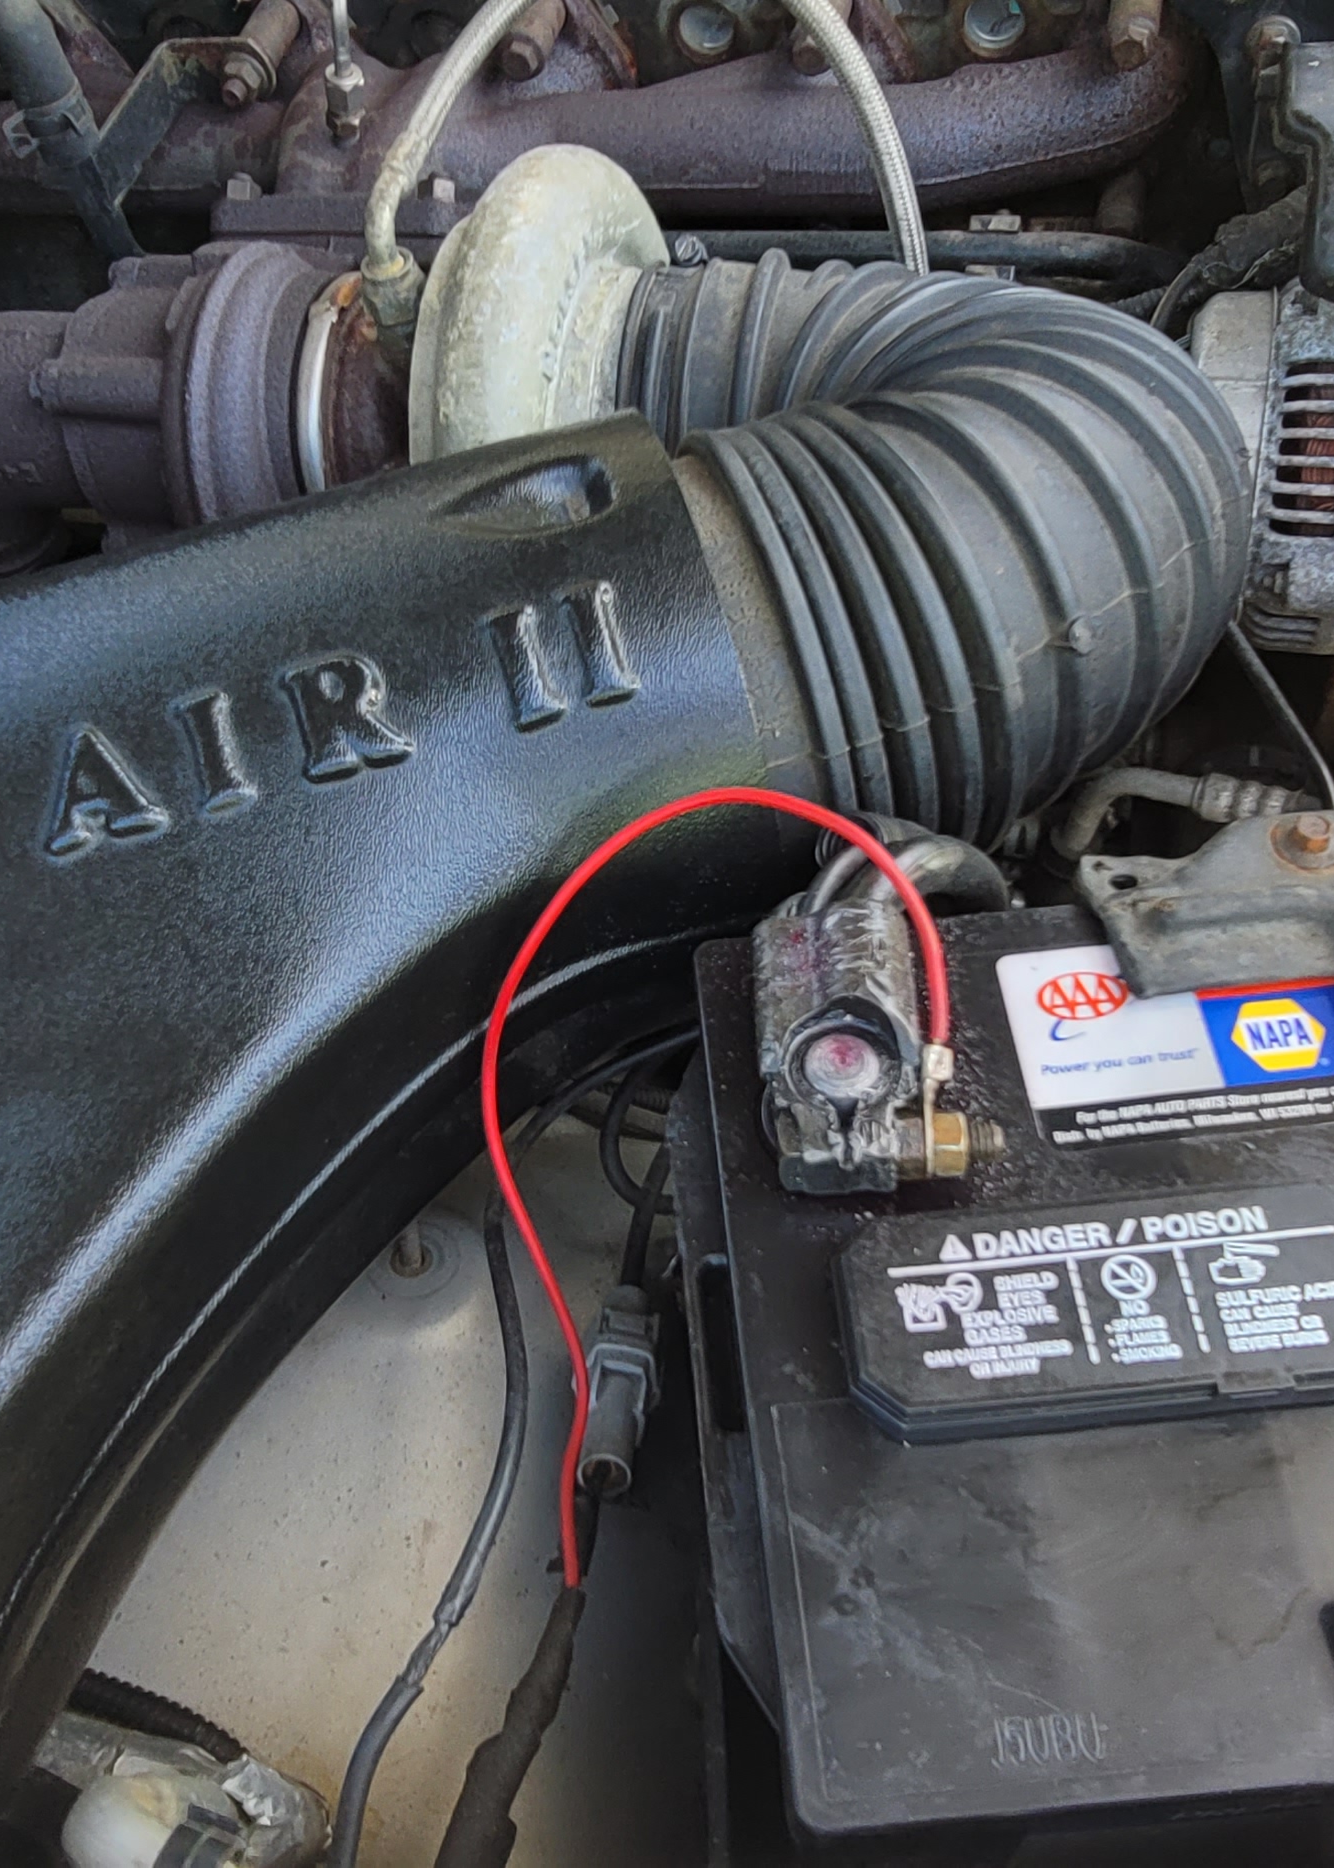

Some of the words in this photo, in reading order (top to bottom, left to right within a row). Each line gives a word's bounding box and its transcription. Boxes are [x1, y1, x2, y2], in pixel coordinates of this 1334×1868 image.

[40, 654, 417, 858] AIR
[478, 579, 642, 734] II
[1043, 972, 1123, 1019] AAA
[1246, 1017, 1313, 1051] NAPA
[1040, 1061, 1089, 1076] Power
[1094, 1057, 1123, 1073] you
[1128, 1053, 1153, 1066] can
[1075, 1110, 1098, 1125] For
[1097, 1108, 1119, 1123] the
[1118, 1103, 1154, 1119] NAPA
[1153, 1099, 1187, 1114] AUTO
[1187, 1096, 1228, 1111] PARTS
[1227, 1093, 1260, 1107] Store
[1101, 1122, 1137, 1138] NAPA
[972, 1221, 1113, 1260] DANGER
[1140, 1205, 1268, 1243] POISON
[993, 1271, 1059, 1292] SHIELD
[997, 1290, 1047, 1309] EYES
[1215, 1284, 1302, 1308] SULFURIC
[961, 1304, 1060, 1328] EXPLOSIVE
[1119, 1299, 1150, 1317] NO
[1219, 1306, 1252, 1322] CAN
[1252, 1302, 1300, 1319] CAUSE
[964, 1325, 1028, 1346] GASES
[1224, 1317, 1299, 1337] BLINDNESS
[1299, 1314, 1324, 1330] OR
[1115, 1330, 1170, 1346] FLAMES
[1228, 1334, 1283, 1354] SEVERE
[1282, 1329, 1329, 1347] BURNS
[923, 1349, 958, 1368] CAN
[954, 1345, 999, 1365] CAUSE
[998, 1339, 1073, 1362] BLINDNESS
[1119, 1343, 1183, 1365] SMOKING
[969, 1361, 992, 1379] OR
[992, 1357, 1041, 1378] INJURY
